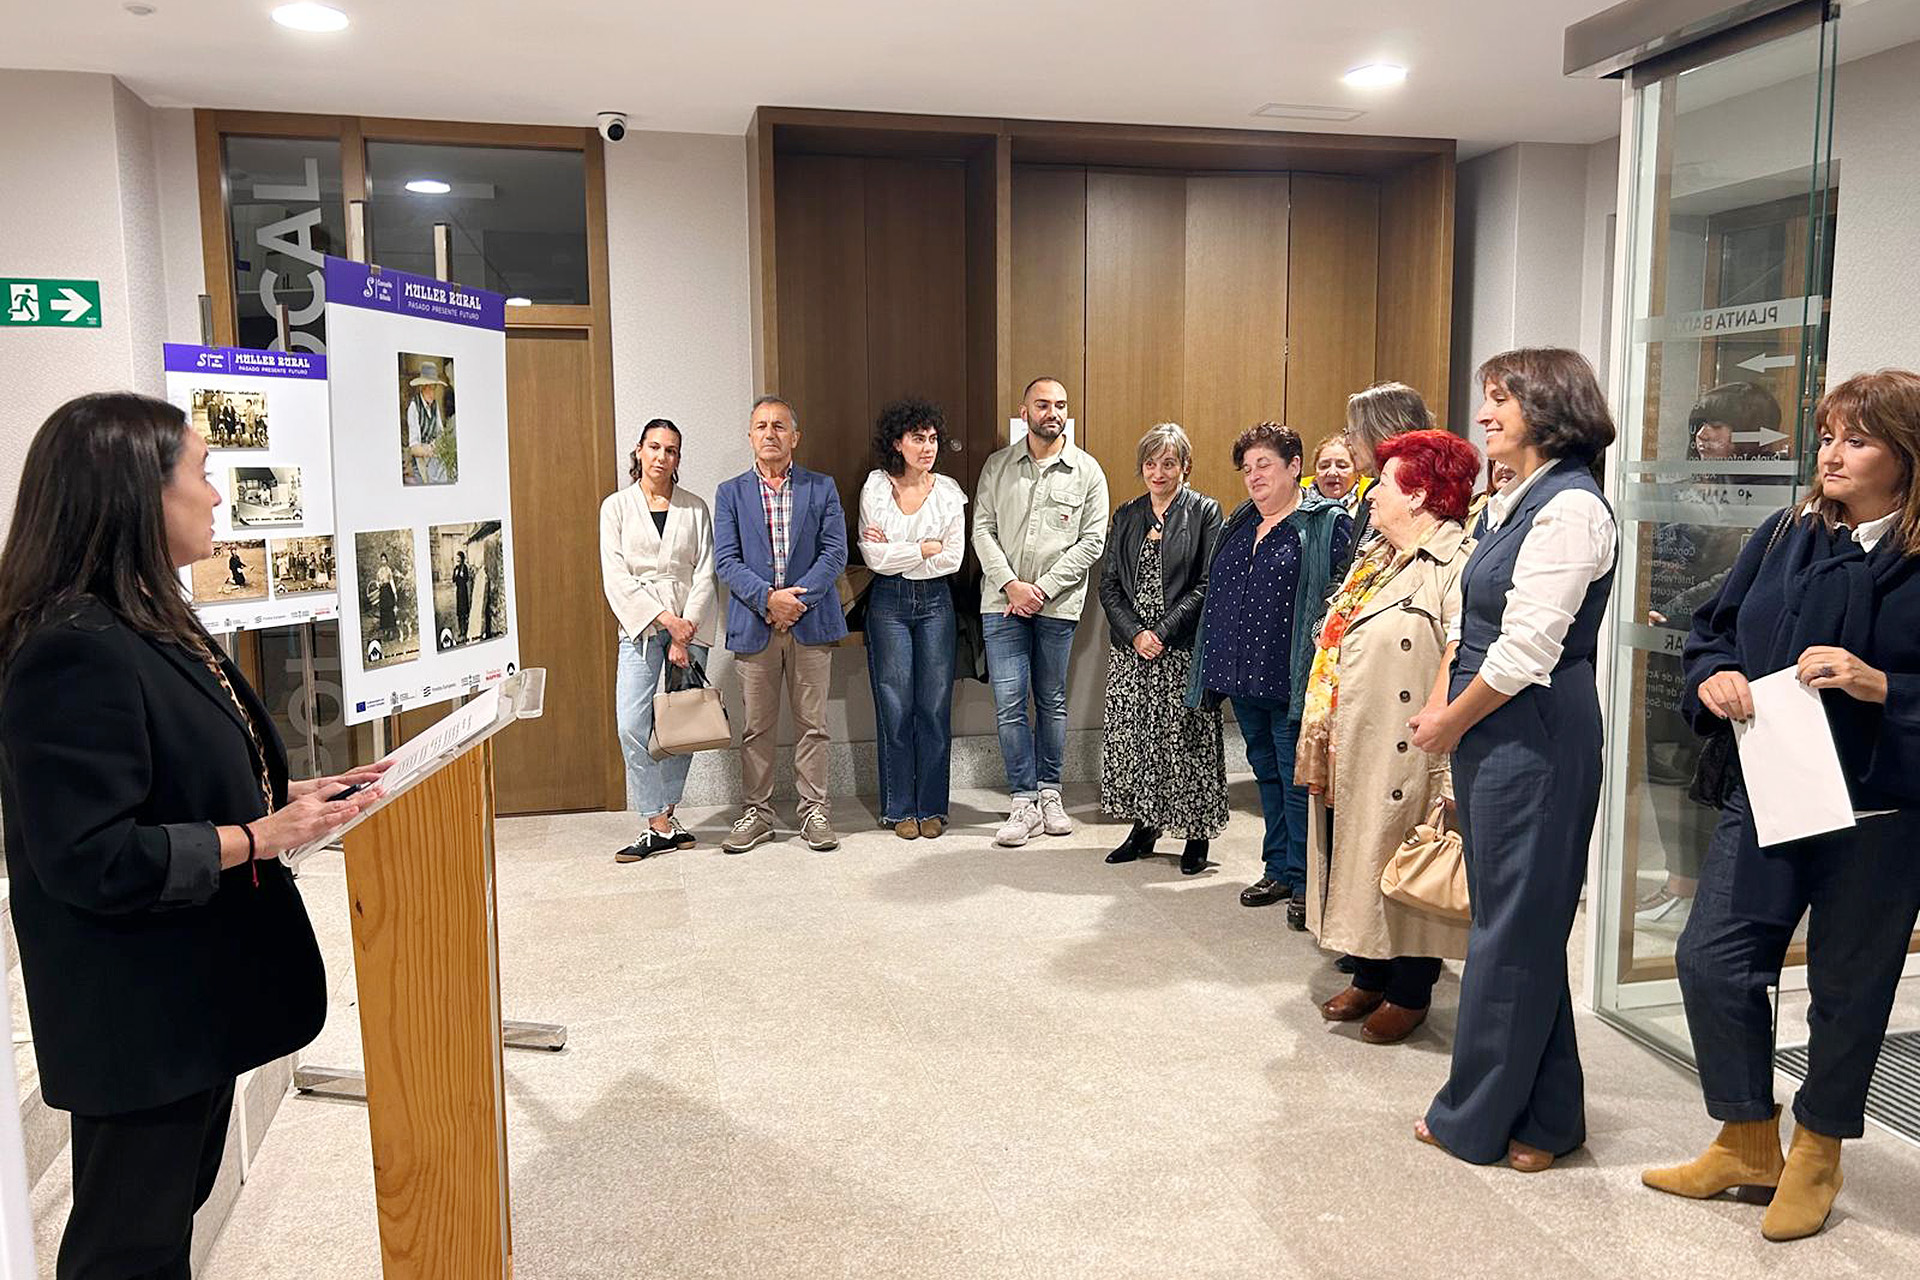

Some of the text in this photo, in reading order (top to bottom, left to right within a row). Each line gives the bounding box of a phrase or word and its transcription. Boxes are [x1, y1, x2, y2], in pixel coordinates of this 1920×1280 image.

[405, 282, 447, 304] MULLER
[449, 291, 482, 310] RURAL
[408, 301, 480, 321] PASADO PRESENTE FUTURO
[235, 353, 276, 366] MULLER
[277, 356, 311, 369] RURAL
[261, 366, 287, 374] PRESENTE
[288, 367, 308, 375] FUTURO
